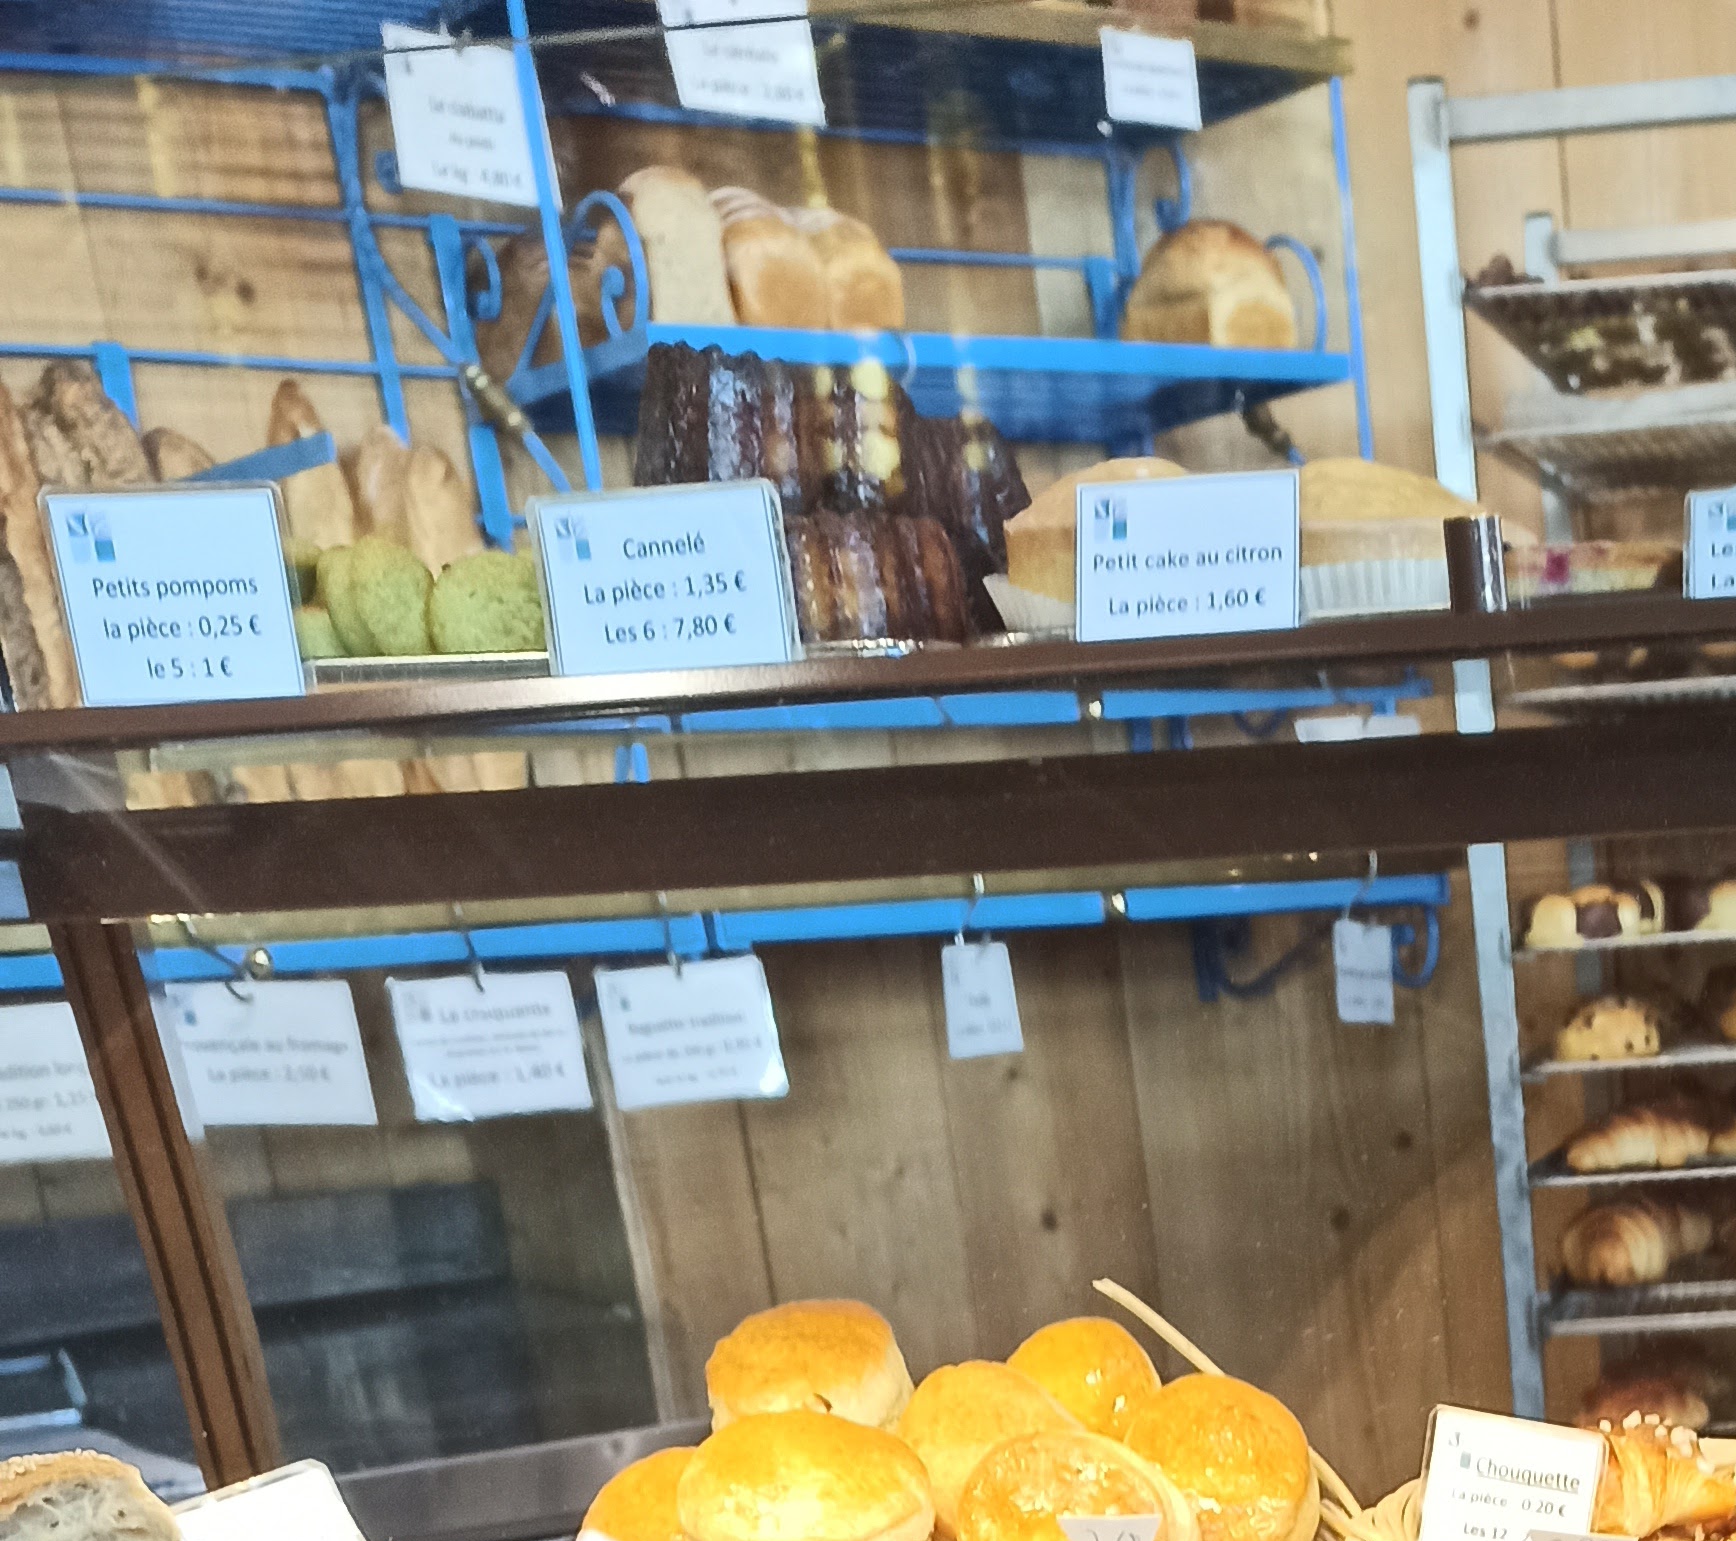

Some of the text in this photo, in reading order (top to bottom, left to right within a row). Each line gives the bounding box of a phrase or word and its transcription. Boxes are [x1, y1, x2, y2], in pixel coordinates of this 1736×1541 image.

[623, 530, 706, 560] Cannelé
[1093, 545, 1282, 572] Petit cake au citron
[92, 577, 258, 601] Petits pompoms
[584, 569, 747, 607] La pièce 1,35 €
[1711, 573, 1735, 591] La
[1109, 587, 1266, 619] La pièce 1,60 €
[103, 613, 262, 642] la pièce 0,25 €
[604, 612, 737, 645] Les 6 7,80 €
[147, 656, 233, 679] le 5 1 €
[1476, 1456, 1580, 1491] Chouquette
[1470, 1491, 1508, 1508] pièce
[1521, 1499, 1554, 1515] 020
[1464, 1523, 1486, 1539] Les
[1492, 1526, 1507, 1541] 12
